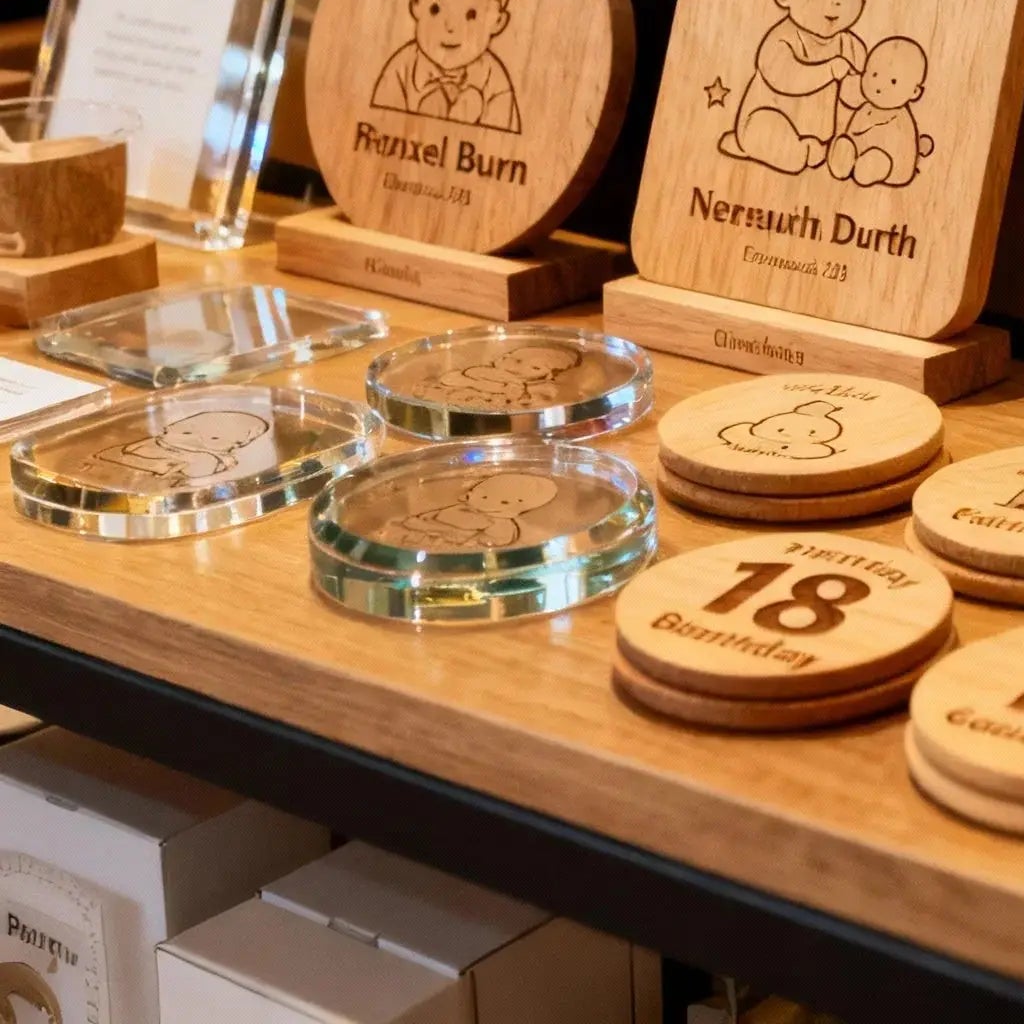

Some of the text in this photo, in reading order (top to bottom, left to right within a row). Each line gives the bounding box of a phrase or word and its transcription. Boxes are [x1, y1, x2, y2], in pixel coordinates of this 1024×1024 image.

[456, 140, 528, 186] Burn
[830, 213, 918, 259] Durth
[703, 562, 870, 636] 18
